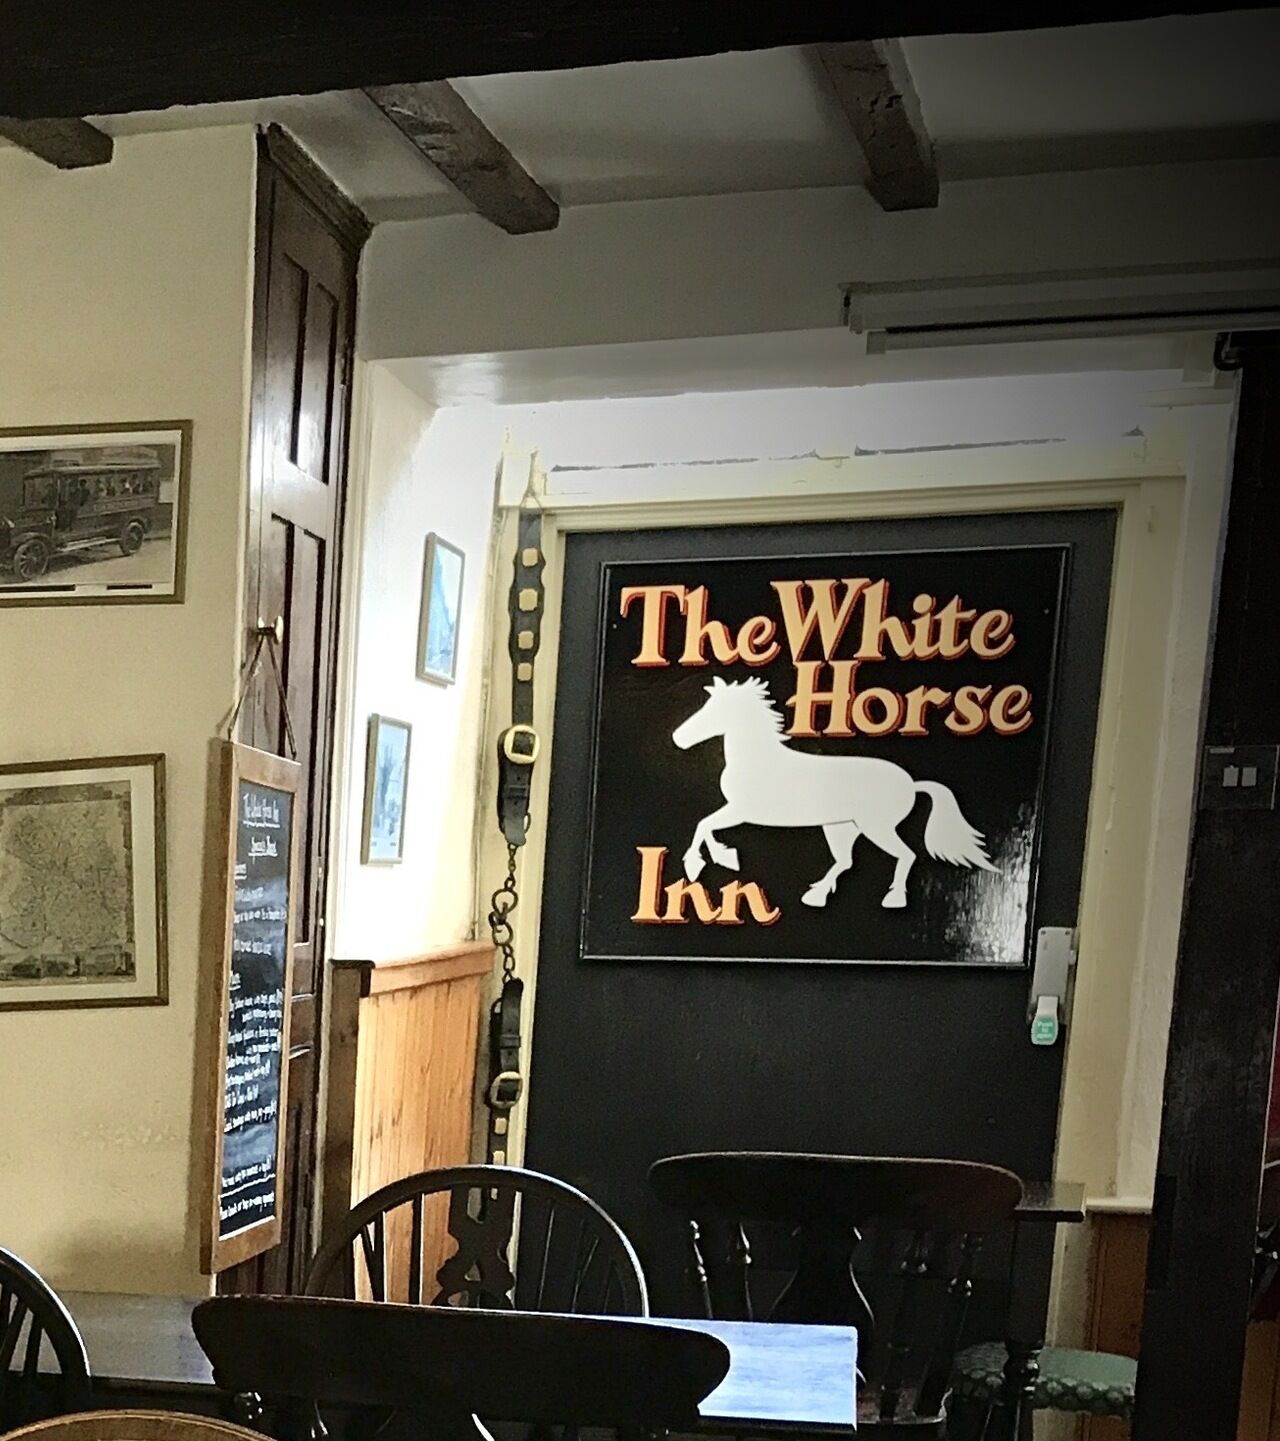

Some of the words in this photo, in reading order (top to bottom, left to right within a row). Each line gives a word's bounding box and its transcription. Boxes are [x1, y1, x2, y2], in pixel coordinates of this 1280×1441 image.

[621, 585, 780, 667] The
[772, 577, 1016, 664] White
[786, 660, 1034, 737] Horse
[630, 846, 780, 925] Inn
